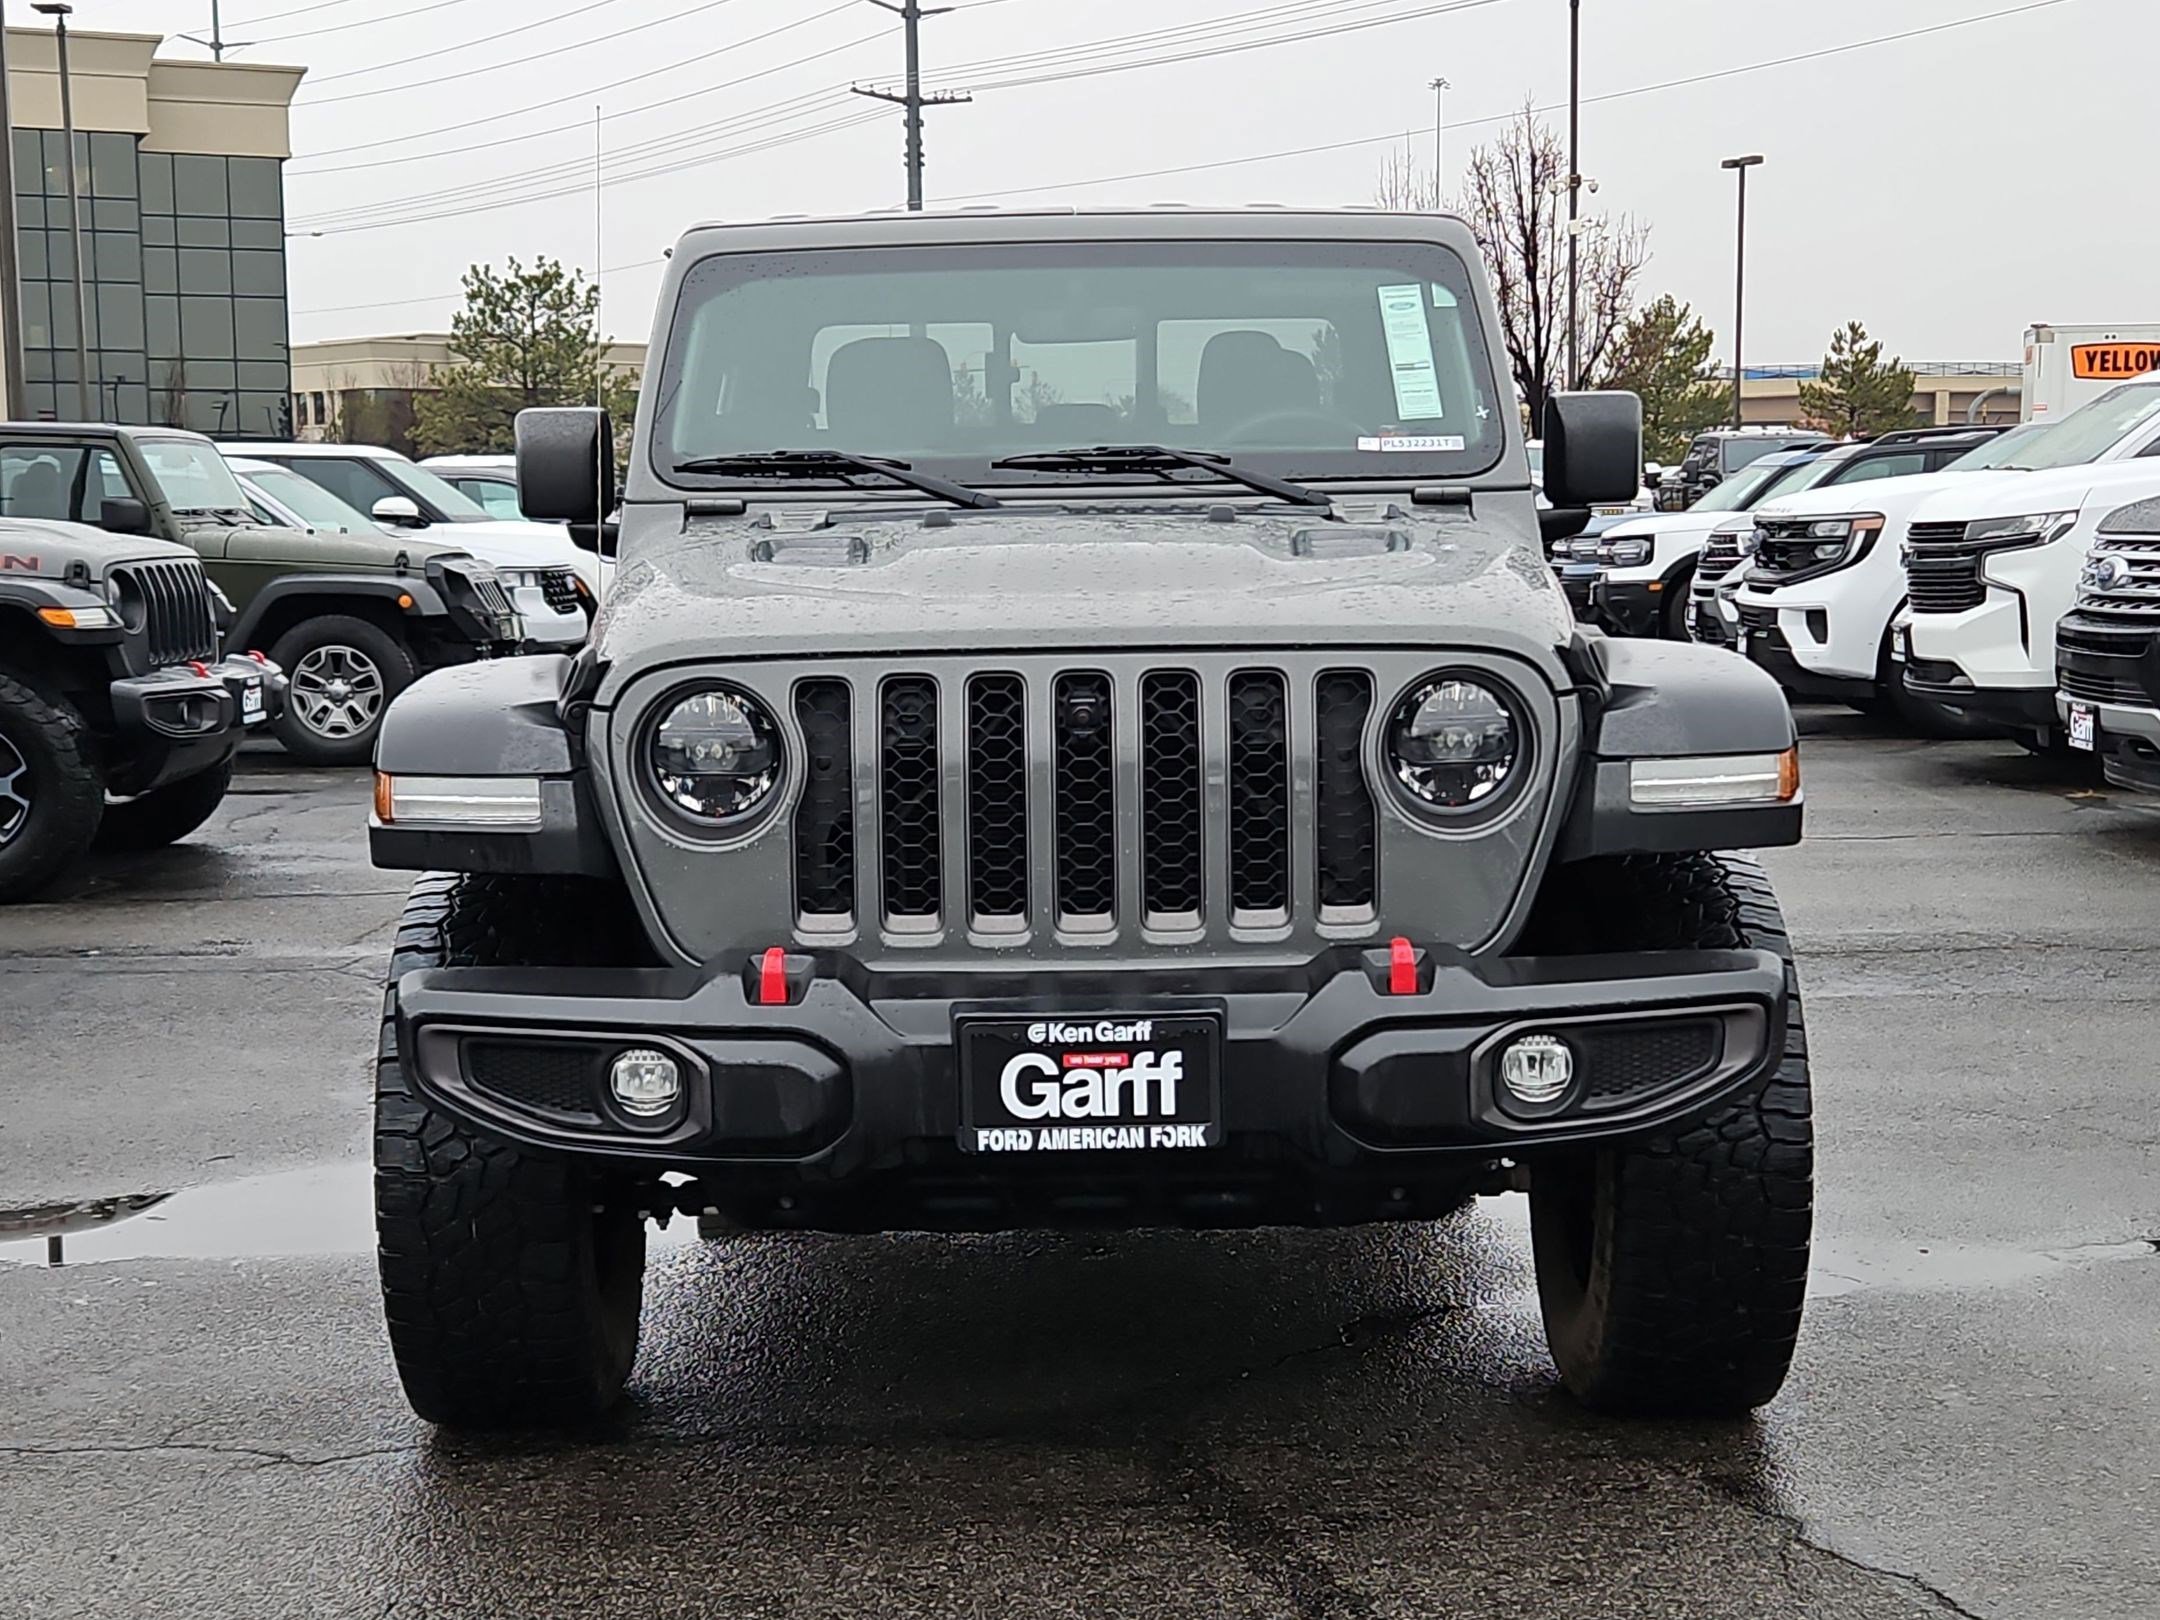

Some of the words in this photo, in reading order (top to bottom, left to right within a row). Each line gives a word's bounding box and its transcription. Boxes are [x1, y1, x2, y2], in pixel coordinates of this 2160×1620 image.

[1048, 1022, 1093, 1042] Ken
[1095, 1021, 1152, 1042] Garff
[1000, 1051, 1183, 1119] Garff
[977, 1128, 1033, 1151] FORD
[1037, 1126, 1145, 1150] AMERICAN
[1150, 1125, 1207, 1148] FORK
